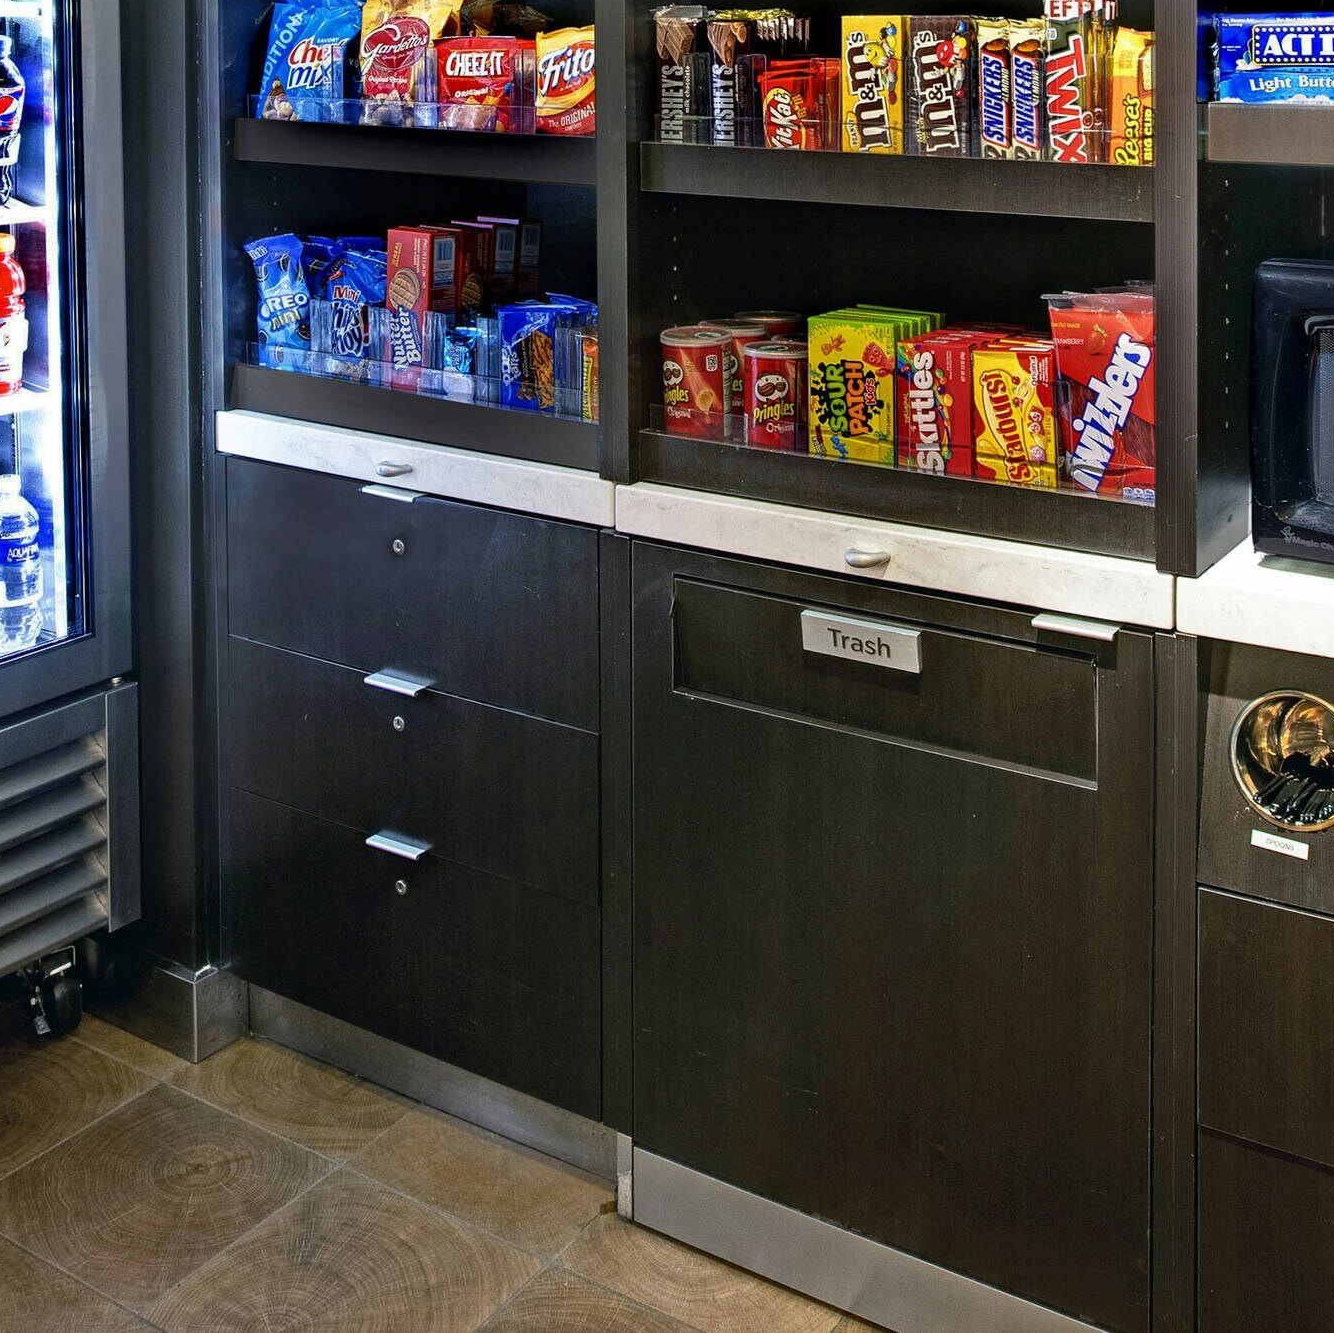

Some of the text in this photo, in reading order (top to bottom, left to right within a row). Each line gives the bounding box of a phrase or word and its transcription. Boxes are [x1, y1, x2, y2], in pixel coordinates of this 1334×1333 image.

[539, 48, 596, 96] Frito
[1263, 33, 1316, 56] ACT
[981, 54, 1006, 145] SNICKERS
[1001, 67, 1009, 103] ALMOND
[1013, 56, 1036, 145] SNICKERS
[1046, 37, 1091, 163] TWIX
[1249, 74, 1293, 93] Light
[1144, 107, 1154, 164] BIG CUP
[753, 401, 795, 429] Pringles
[826, 364, 848, 433] SOUR
[845, 360, 870, 435] PATCH
[910, 349, 945, 477] Skittles
[980, 370, 1031, 482] Starburst
[1071, 332, 1153, 493] wizzlers
[1292, 536, 1320, 548] Magic
[827, 627, 892, 659] Trash
